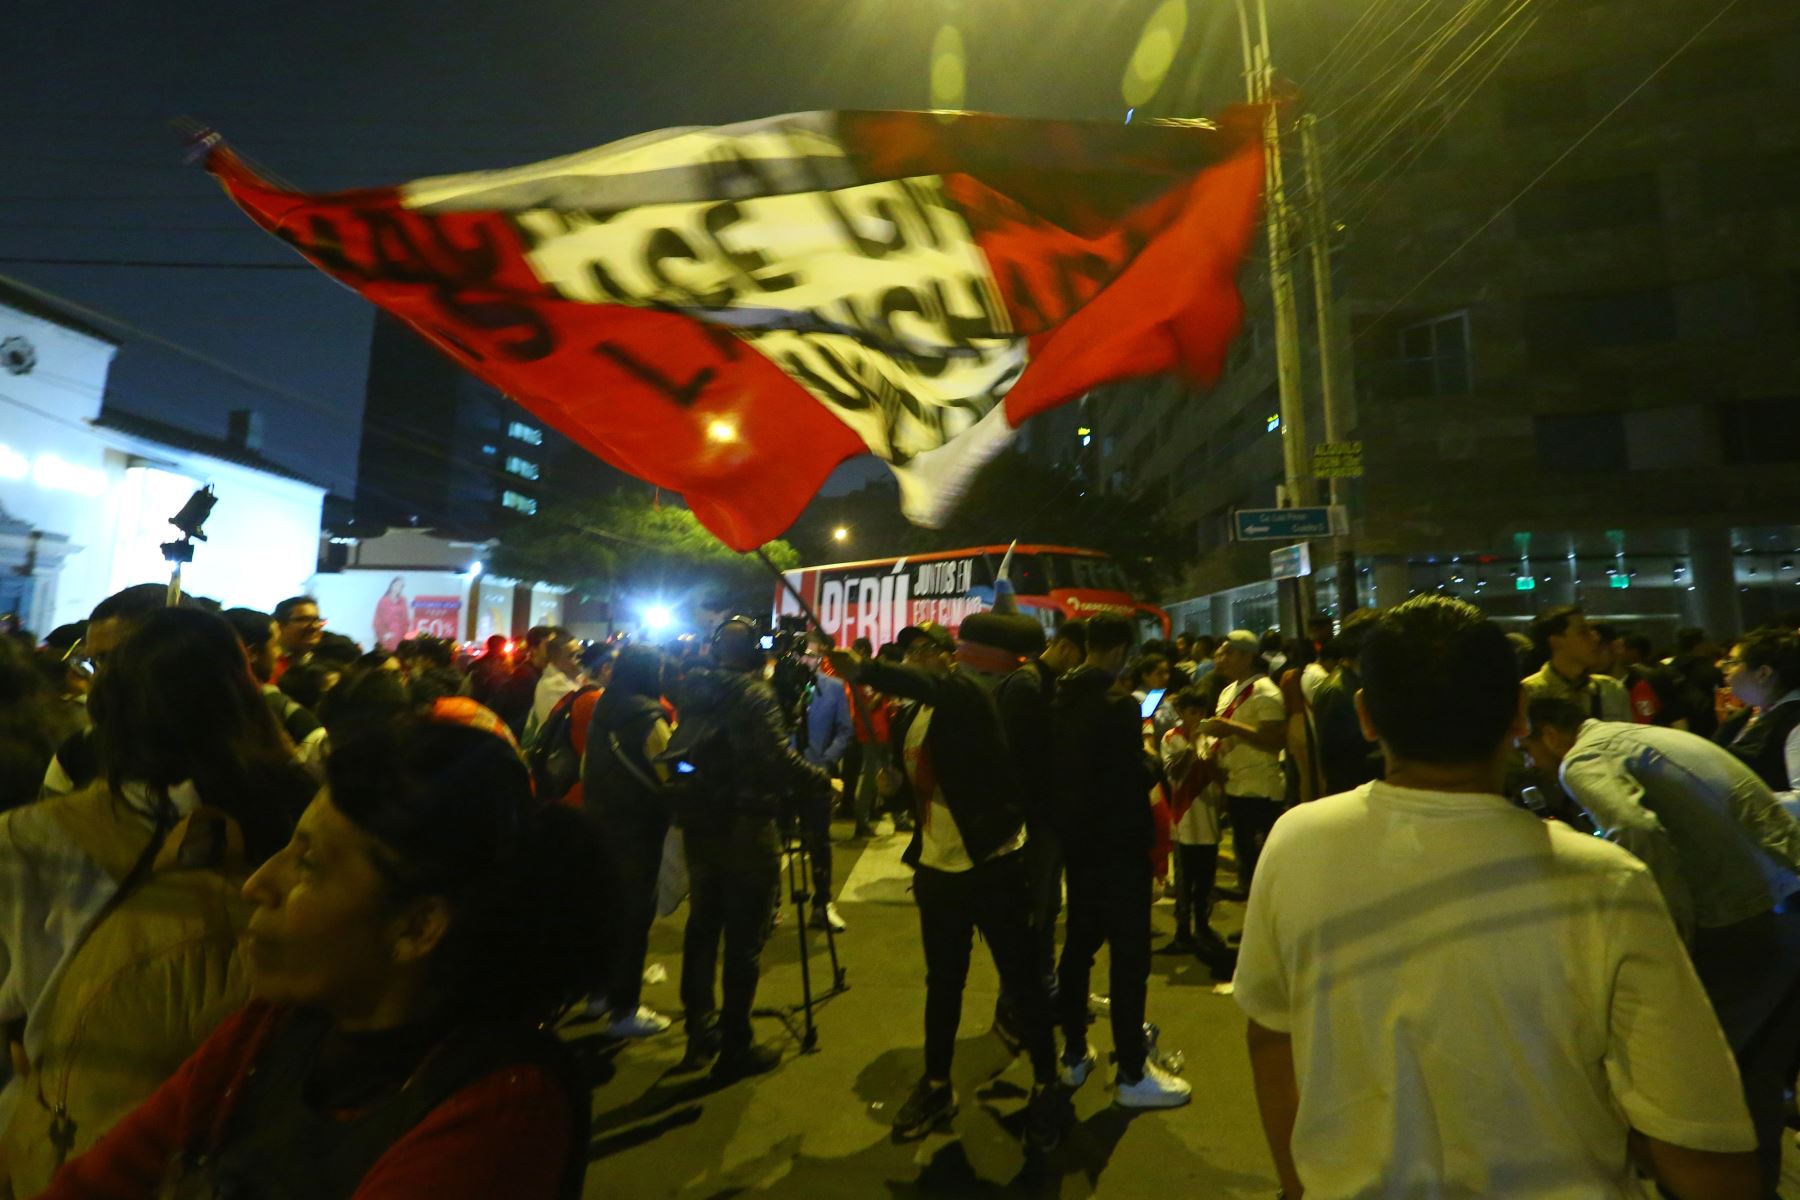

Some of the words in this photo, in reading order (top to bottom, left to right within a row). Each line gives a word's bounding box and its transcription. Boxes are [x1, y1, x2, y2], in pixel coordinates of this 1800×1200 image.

[820, 556, 911, 659] PERÚ
[914, 561, 957, 595] JUNTOS
[956, 557, 974, 592] EN
